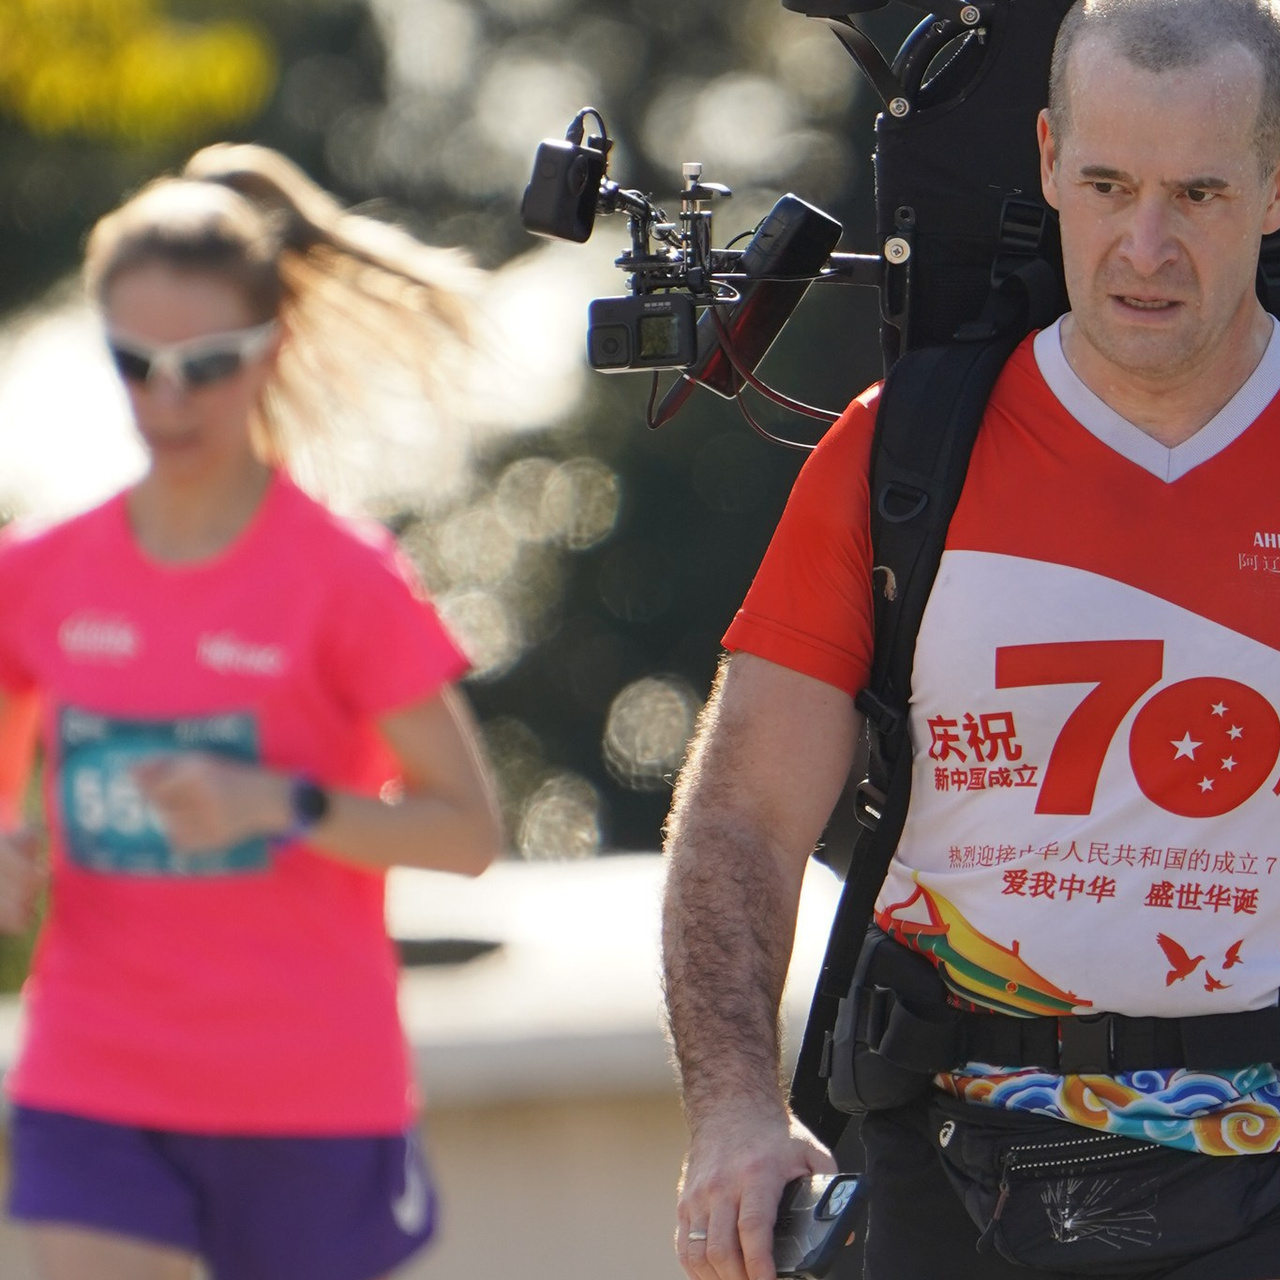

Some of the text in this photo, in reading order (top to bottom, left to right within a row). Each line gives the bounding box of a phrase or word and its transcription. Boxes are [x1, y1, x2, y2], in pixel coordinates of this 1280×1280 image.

[927, 711, 1023, 763] 庆祝
[934, 763, 1038, 792] 新中国成立
[1001, 869, 1260, 915] 爱我中华 盛世华诞
